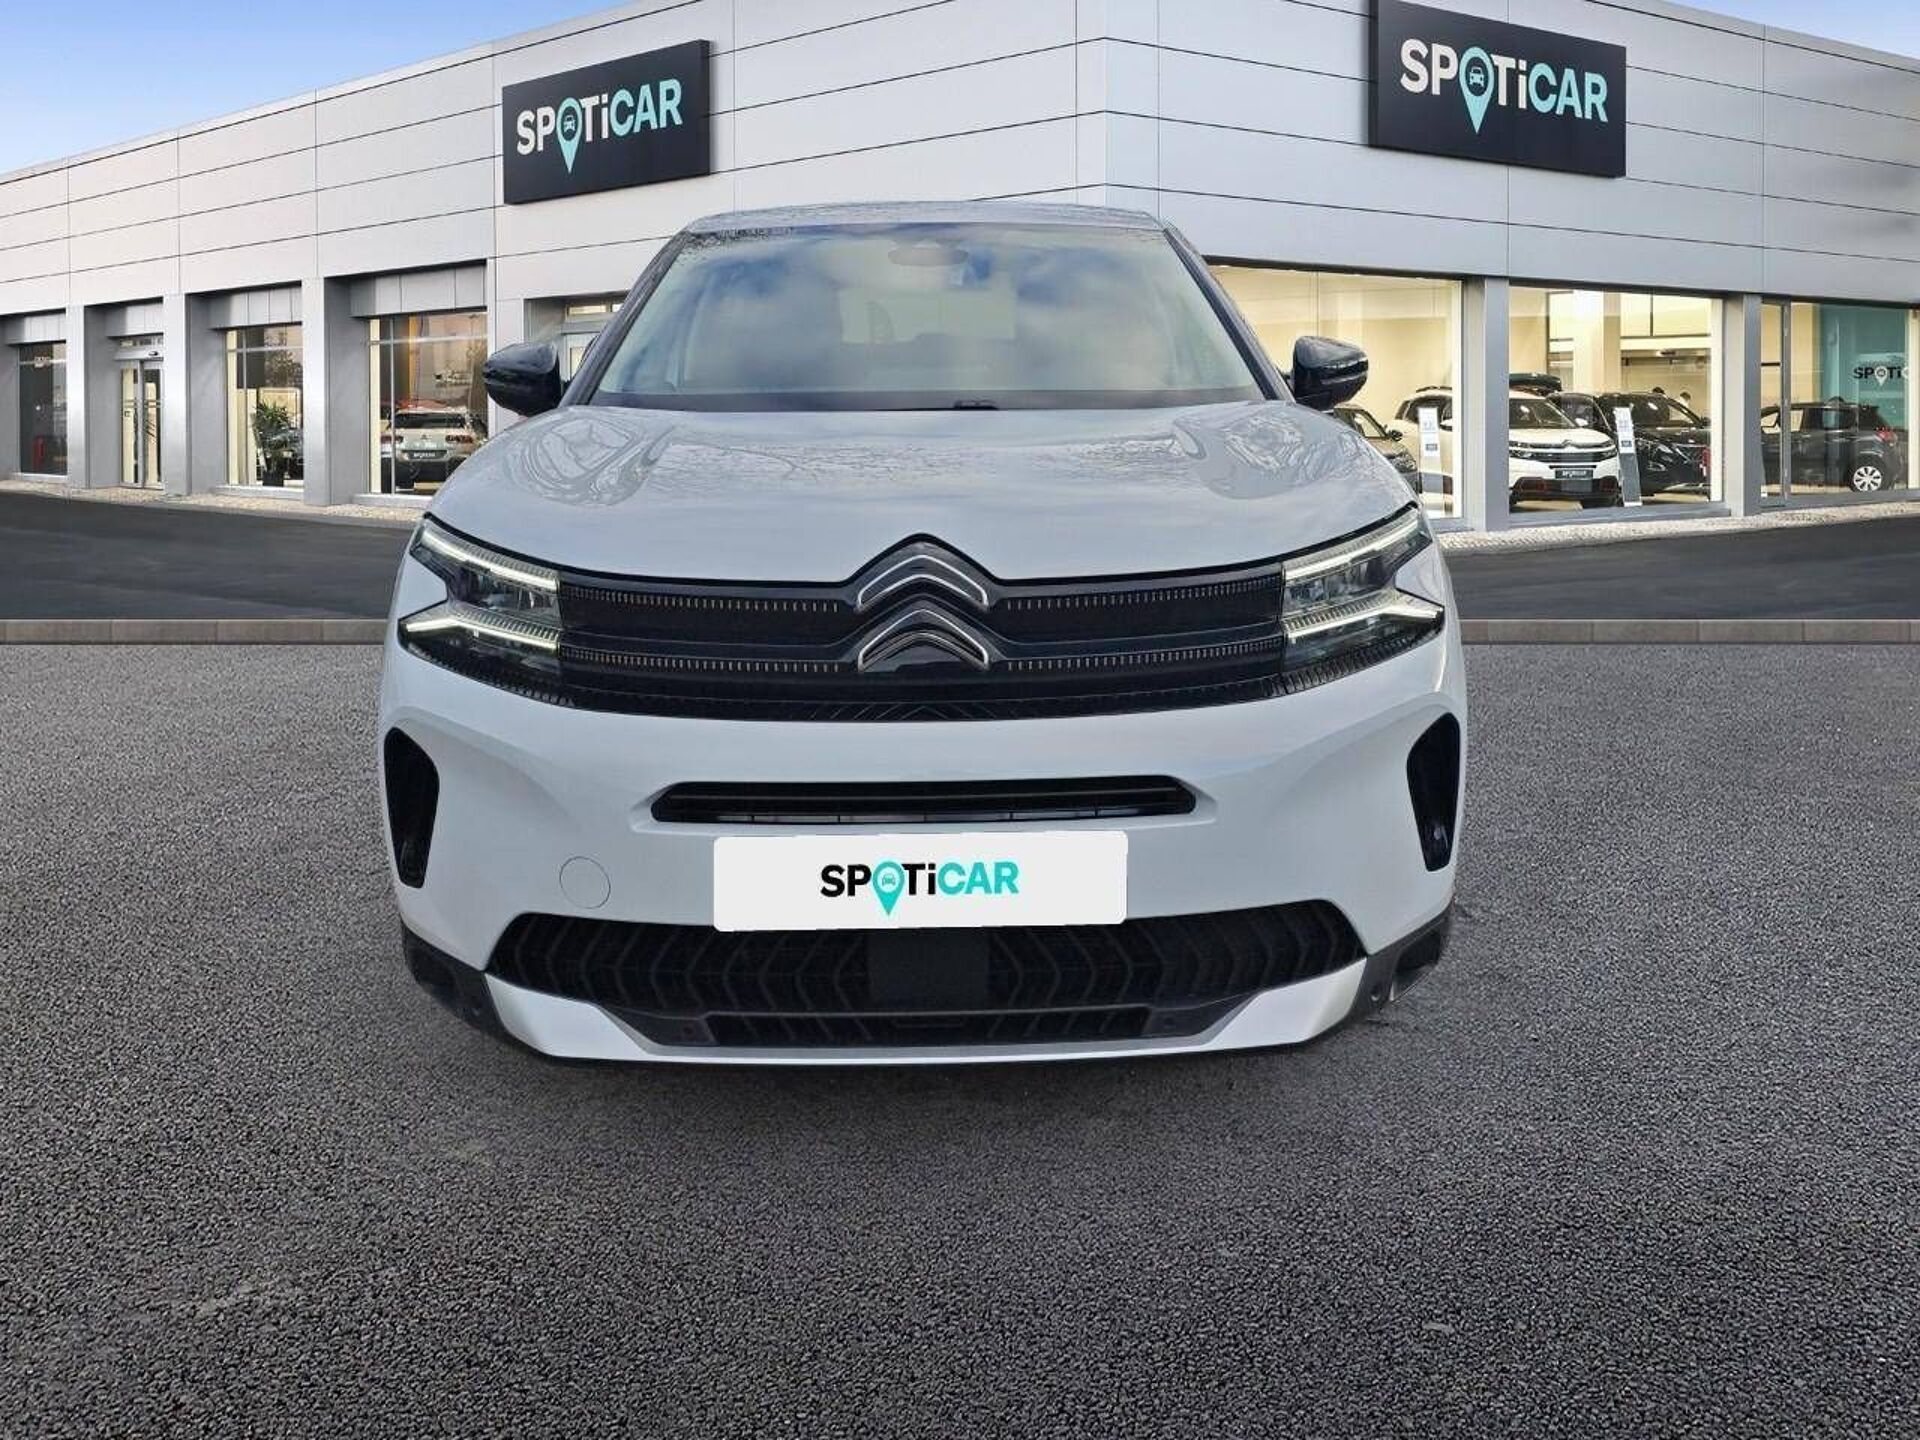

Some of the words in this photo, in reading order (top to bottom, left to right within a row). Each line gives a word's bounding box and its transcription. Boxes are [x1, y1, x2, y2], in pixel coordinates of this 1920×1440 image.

[516, 78, 683, 174] SPOTiCAR
[1400, 38, 1609, 134] SPOTiCAR
[820, 861, 1020, 916] SPOTiCAR
